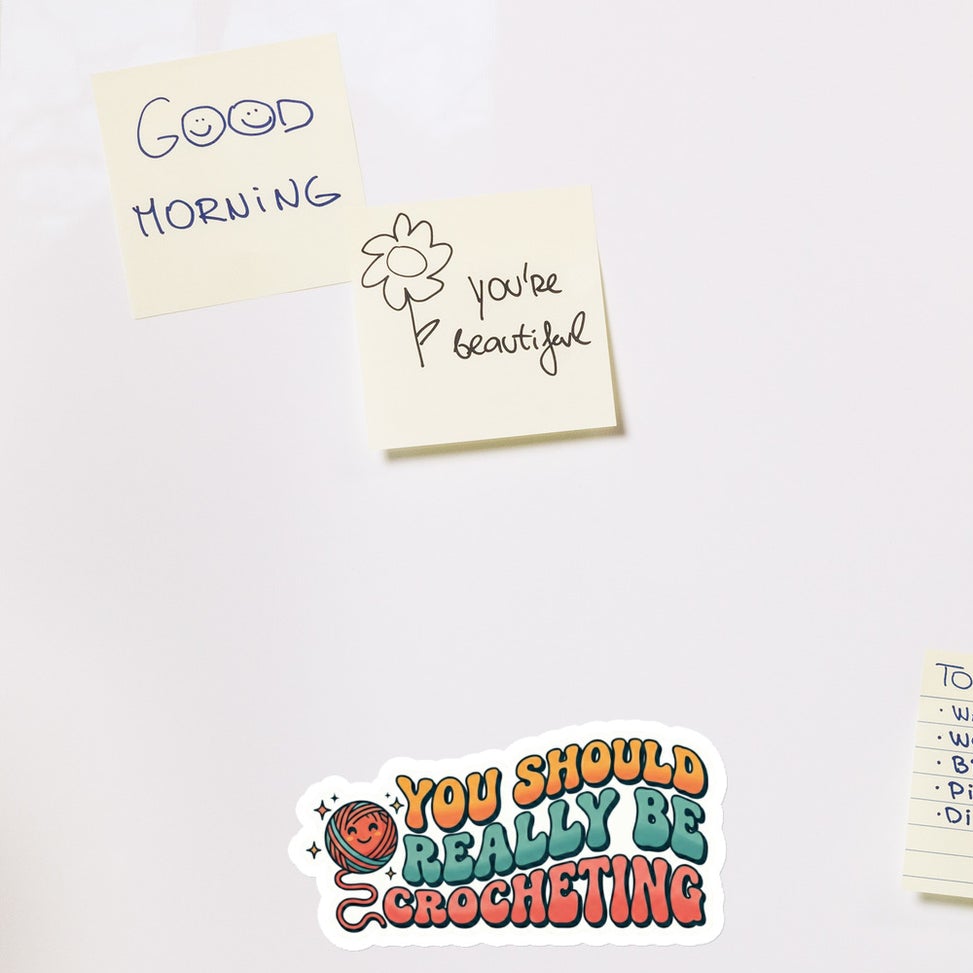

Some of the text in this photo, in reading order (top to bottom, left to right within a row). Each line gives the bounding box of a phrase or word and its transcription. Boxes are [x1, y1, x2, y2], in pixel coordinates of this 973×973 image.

[136, 96, 314, 159] GOOD
[453, 310, 592, 377] beautiful
[935, 662, 973, 690] TO
[397, 737, 709, 833] YOU SHOULD
[402, 786, 709, 888] REALLY BE
[381, 853, 707, 929] CROCHETING
